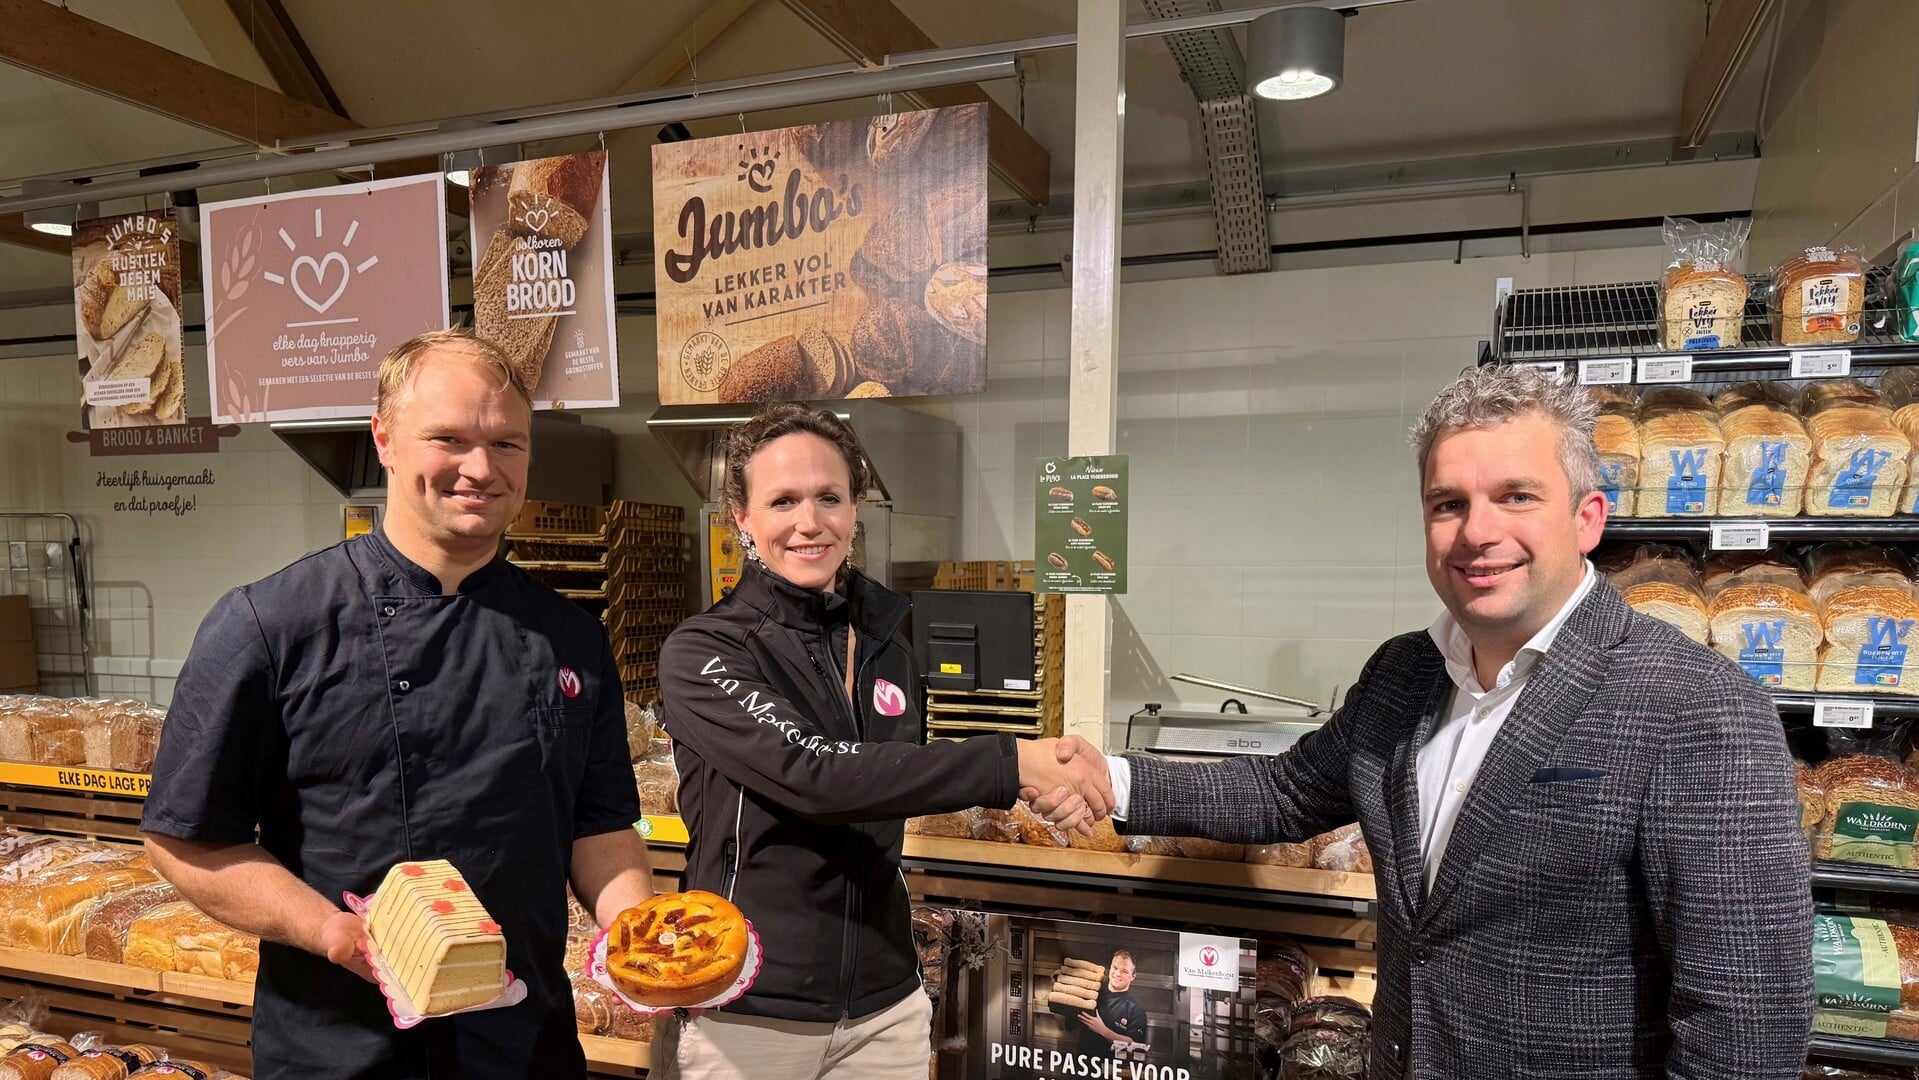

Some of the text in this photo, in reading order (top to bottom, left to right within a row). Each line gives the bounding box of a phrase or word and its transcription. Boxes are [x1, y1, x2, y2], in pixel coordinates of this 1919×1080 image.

[105, 215, 172, 250] JUMBO'S
[664, 167, 864, 284] Jumbo's
[515, 234, 563, 251] volkoren
[112, 252, 166, 272] RUSTIEK
[511, 250, 568, 282] KORN
[119, 269, 161, 287] DESEM
[714, 252, 833, 295] LEKKER VOL
[127, 284, 156, 301] MAIS
[506, 279, 577, 312] BROOD
[702, 271, 847, 319] VAN KARAKTER
[272, 331, 378, 352] elke dag knapperig
[281, 346, 370, 367] vers van Jumbo
[102, 427, 204, 447] BROOD & BANKET
[95, 468, 216, 491] Heerlijk huisgemaakt
[114, 502, 127, 512] en
[128, 495, 148, 512] dat
[1226, 738, 1262, 749] abo
[58, 771, 81, 786] ELKE
[83, 774, 107, 789] DAG
[109, 776, 136, 792] LAGE
[1846, 816, 1908, 832] WALDKORN
[1845, 850, 1895, 860] AUTHENTIC
[990, 1042, 1044, 1071] PURE
[1049, 1050, 1123, 1080] PASSIE
